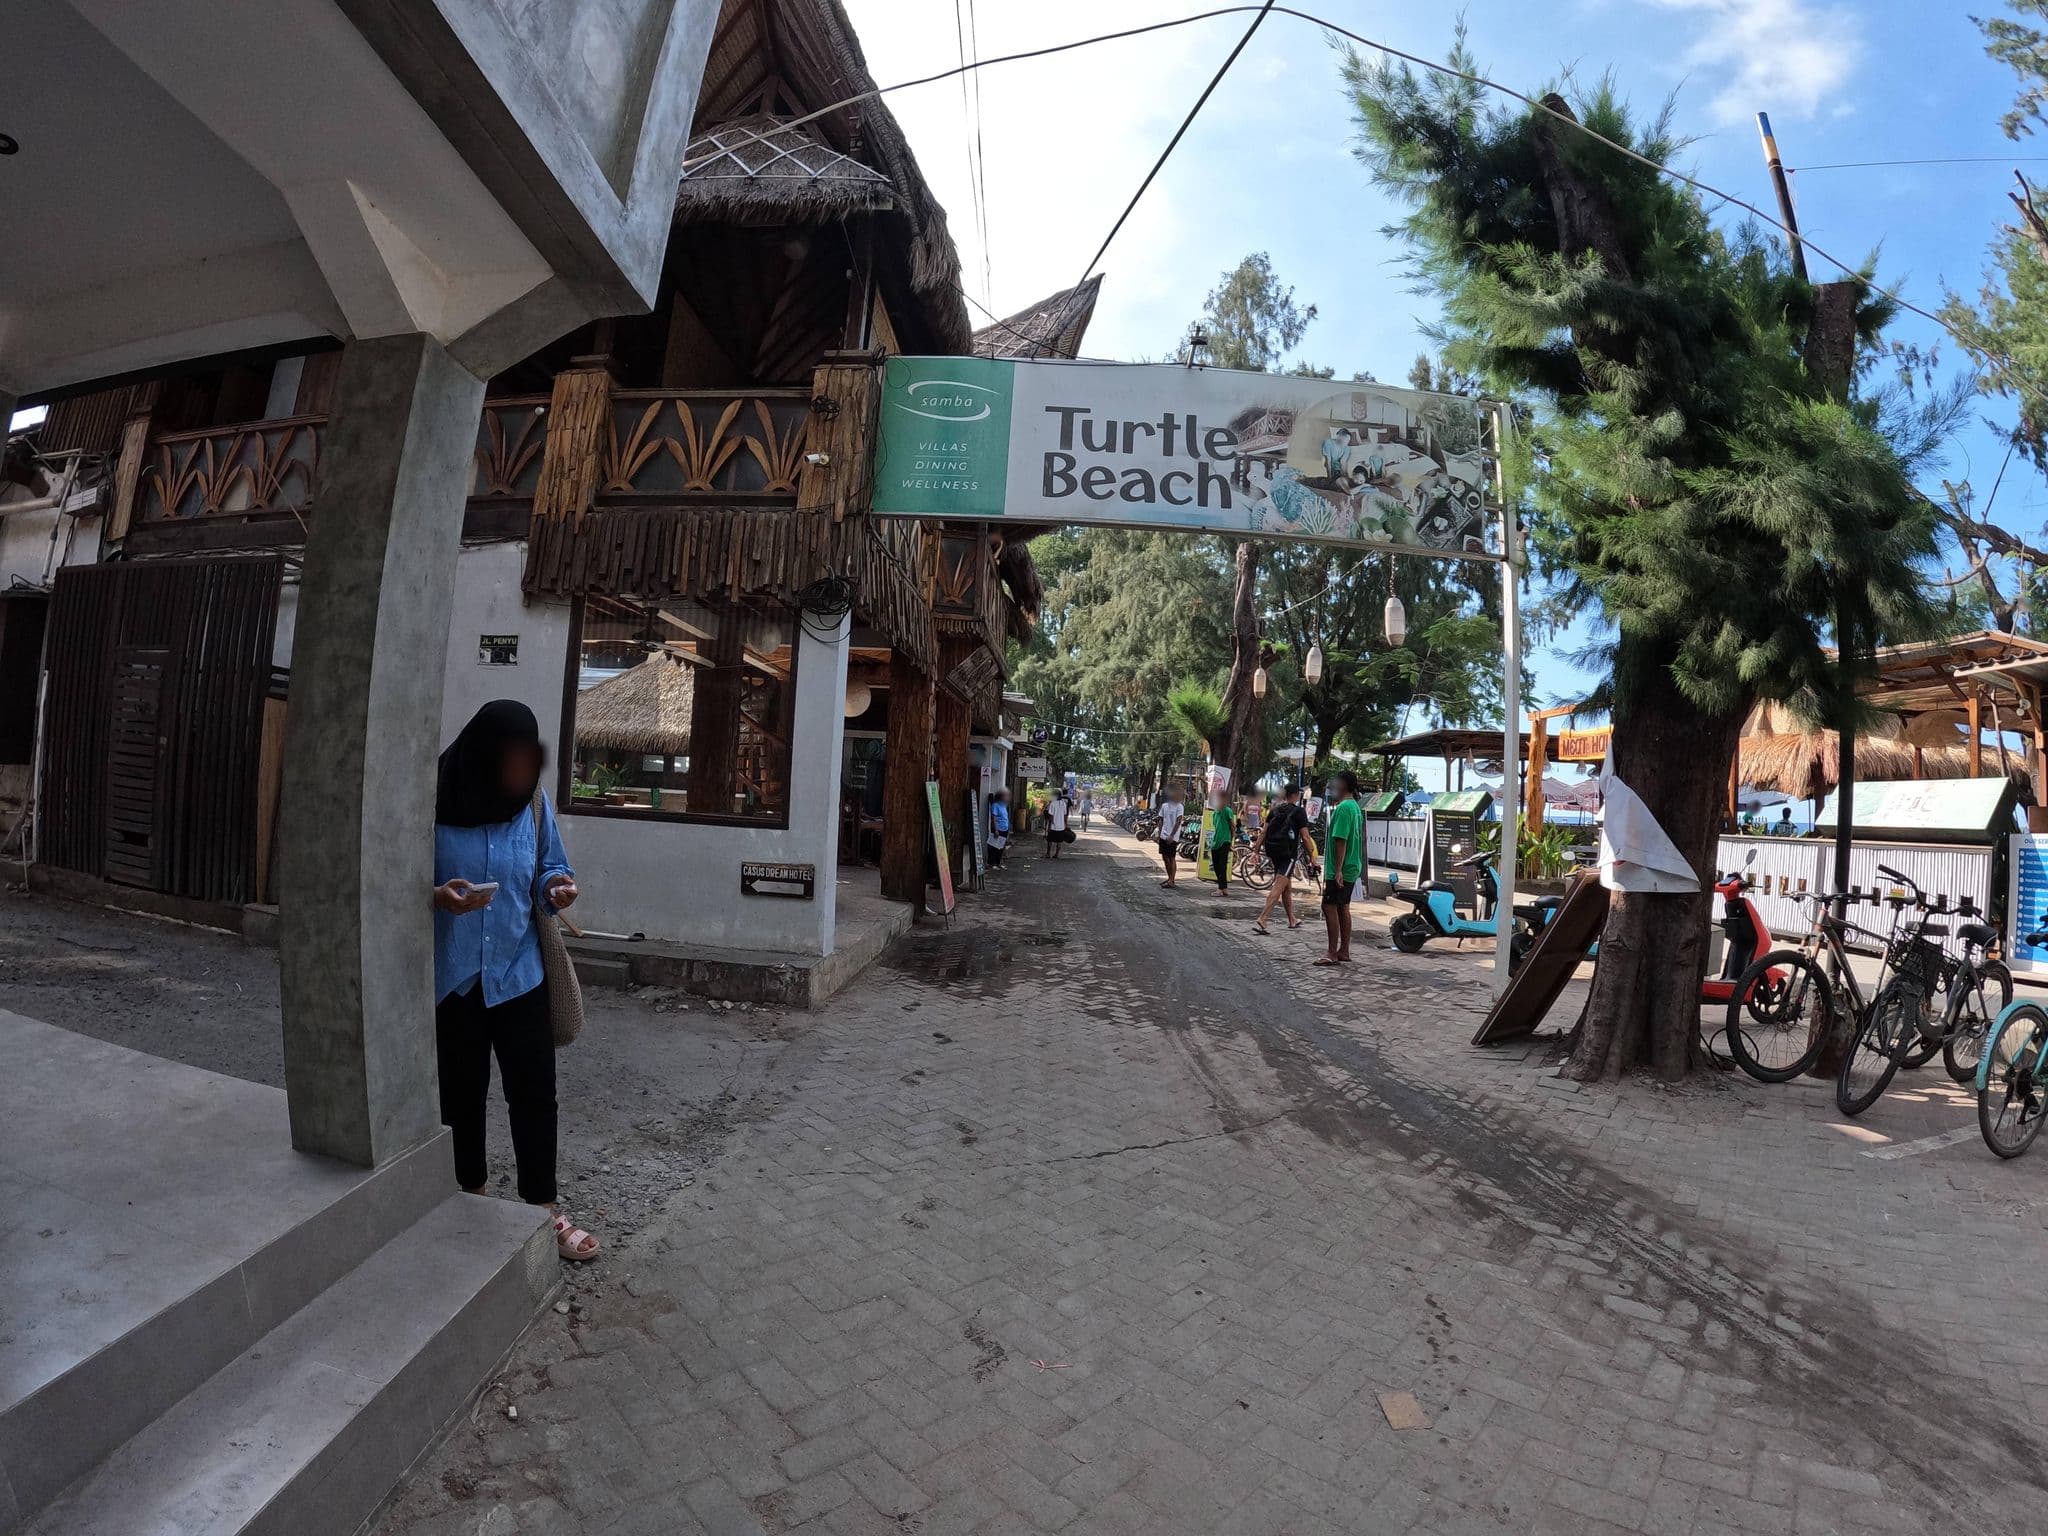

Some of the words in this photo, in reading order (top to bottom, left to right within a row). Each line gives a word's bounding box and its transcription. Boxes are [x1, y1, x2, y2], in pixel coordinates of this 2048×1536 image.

[921, 395, 973, 407] samba
[1045, 405, 1239, 461] Turtle
[919, 442, 968, 452] VILLAS
[915, 460, 968, 471] DINING
[902, 479, 979, 490] WELLNESS
[1042, 452, 1232, 509] Beach
[766, 867, 788, 878] DREAM
[789, 870, 812, 880] HOTEL
